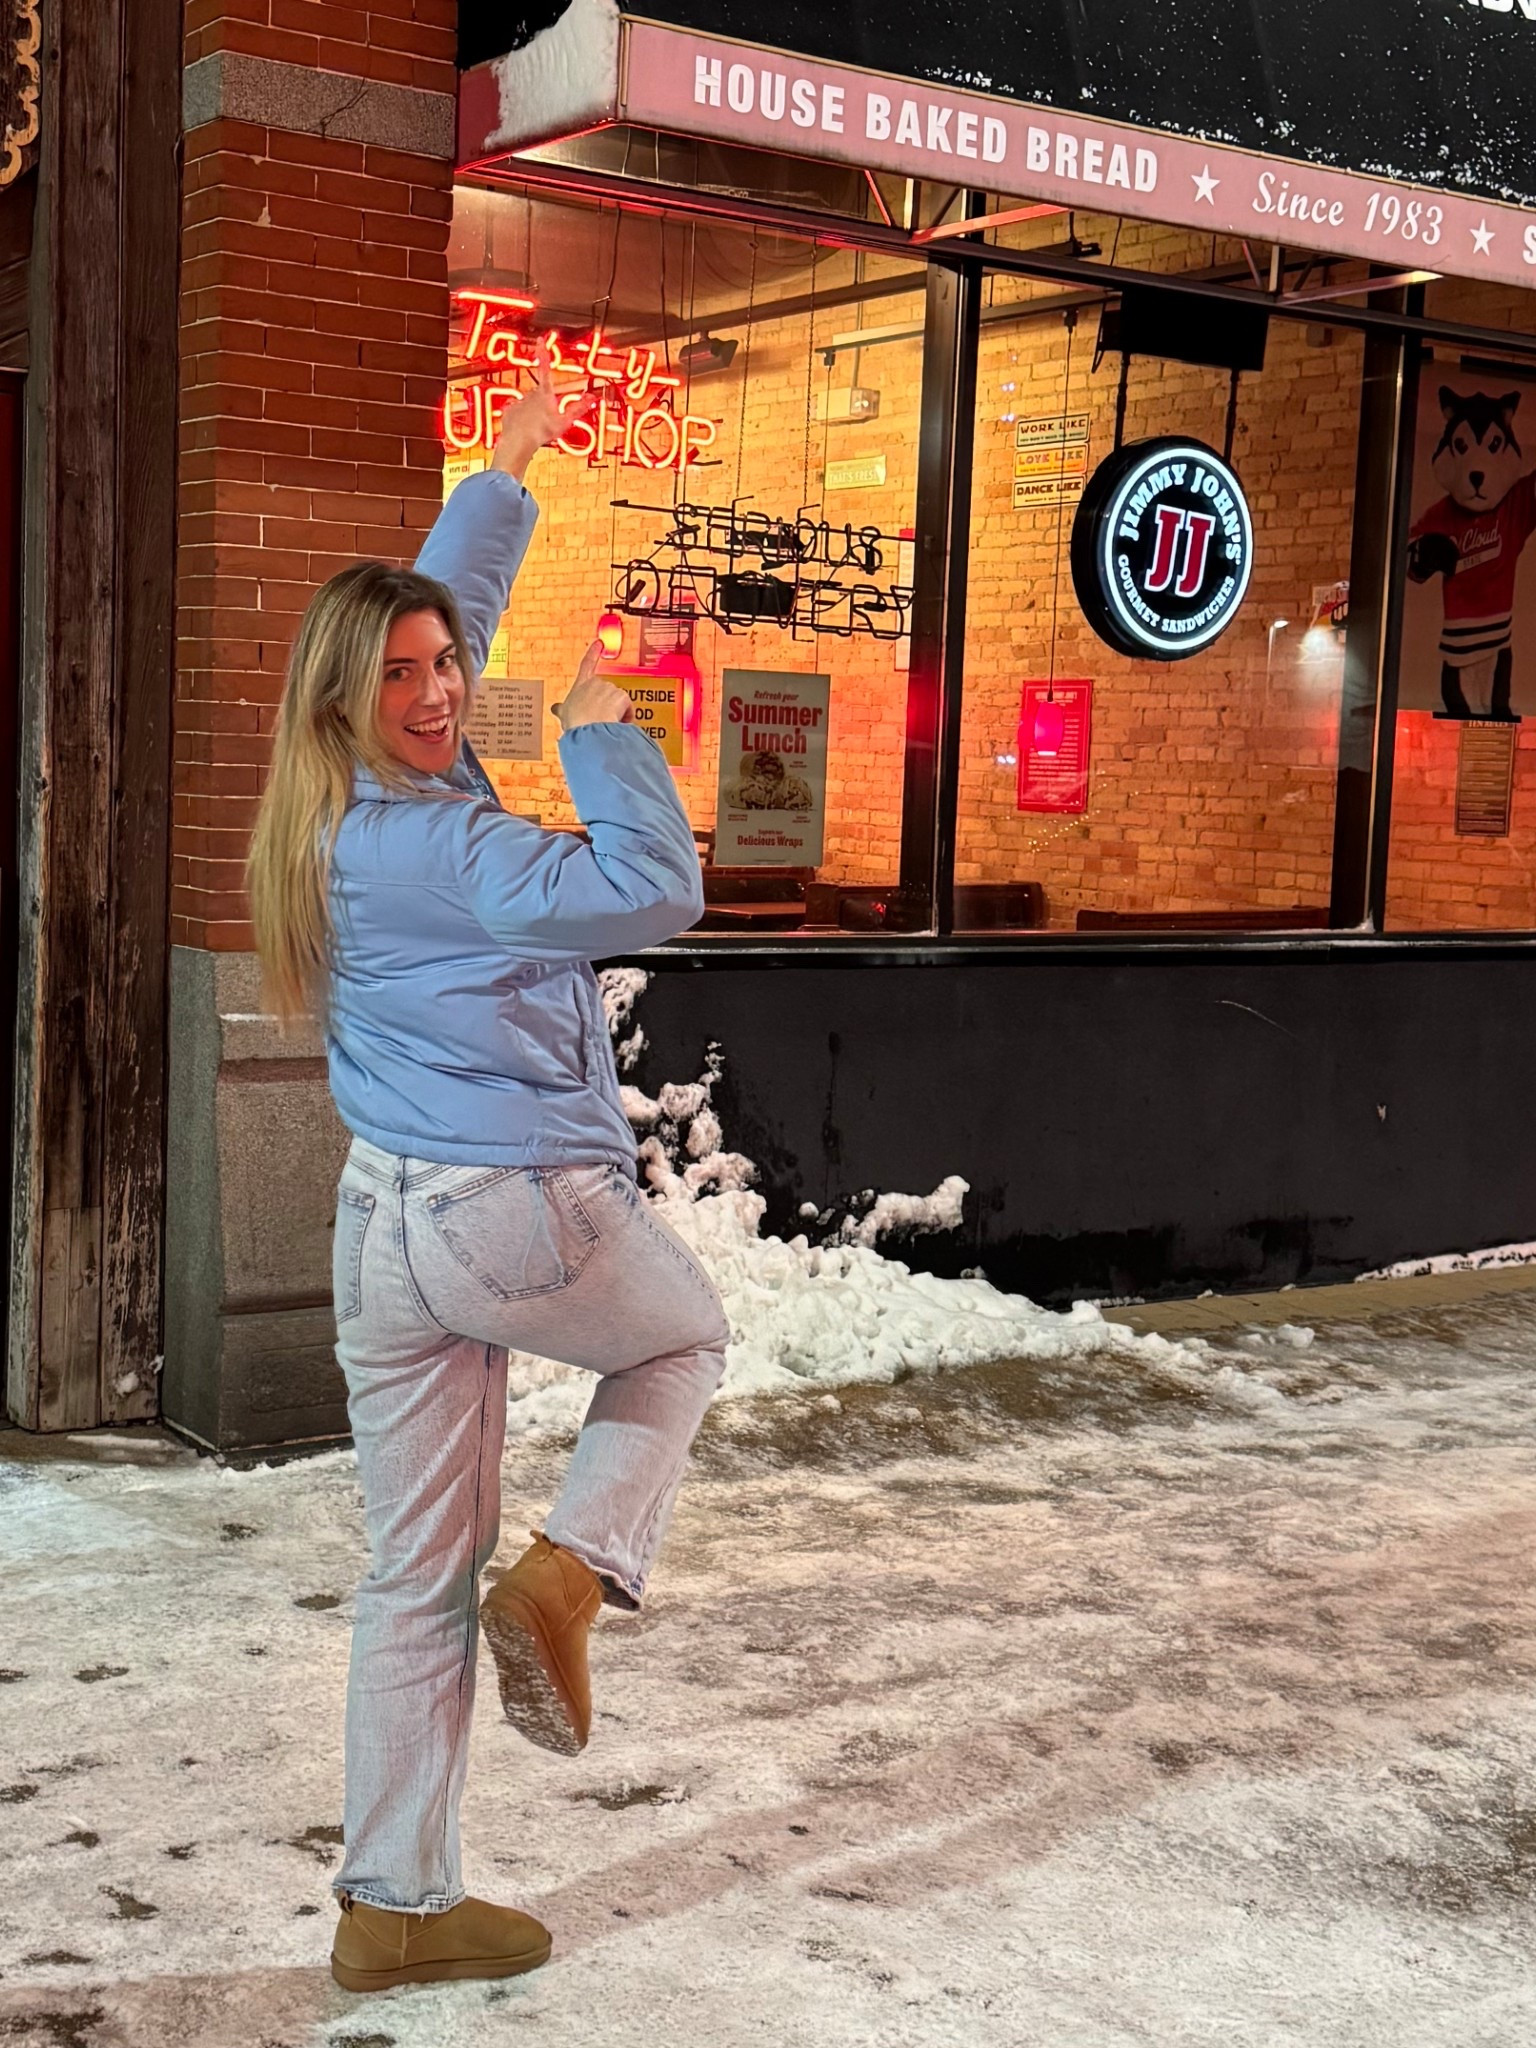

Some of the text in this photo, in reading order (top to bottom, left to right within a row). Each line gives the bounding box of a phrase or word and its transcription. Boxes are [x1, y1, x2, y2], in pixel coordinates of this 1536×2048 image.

[695, 55, 1159, 192] HOUSE BAKED BREAD
[1252, 171, 1443, 246] Since 1983
[459, 292, 681, 399] Tasty
[558, 394, 715, 473] SHOP
[1020, 418, 1086, 434] WORK LIKE
[1018, 452, 1050, 465] LOVE
[1016, 481, 1082, 496] DANCE LIKE
[1119, 463, 1242, 562] JIMMY JOHN'S
[1144, 504, 1216, 597] JJ
[1462, 520, 1499, 553] Cloud
[1117, 554, 1236, 633] GOURMET SANDWICHES
[625, 690, 675, 702] UTSIDE
[728, 696, 823, 727] Summer
[754, 690, 799, 703] Refresh your
[741, 725, 807, 754] Lunch
[737, 834, 803, 848] Delicious Wraps
